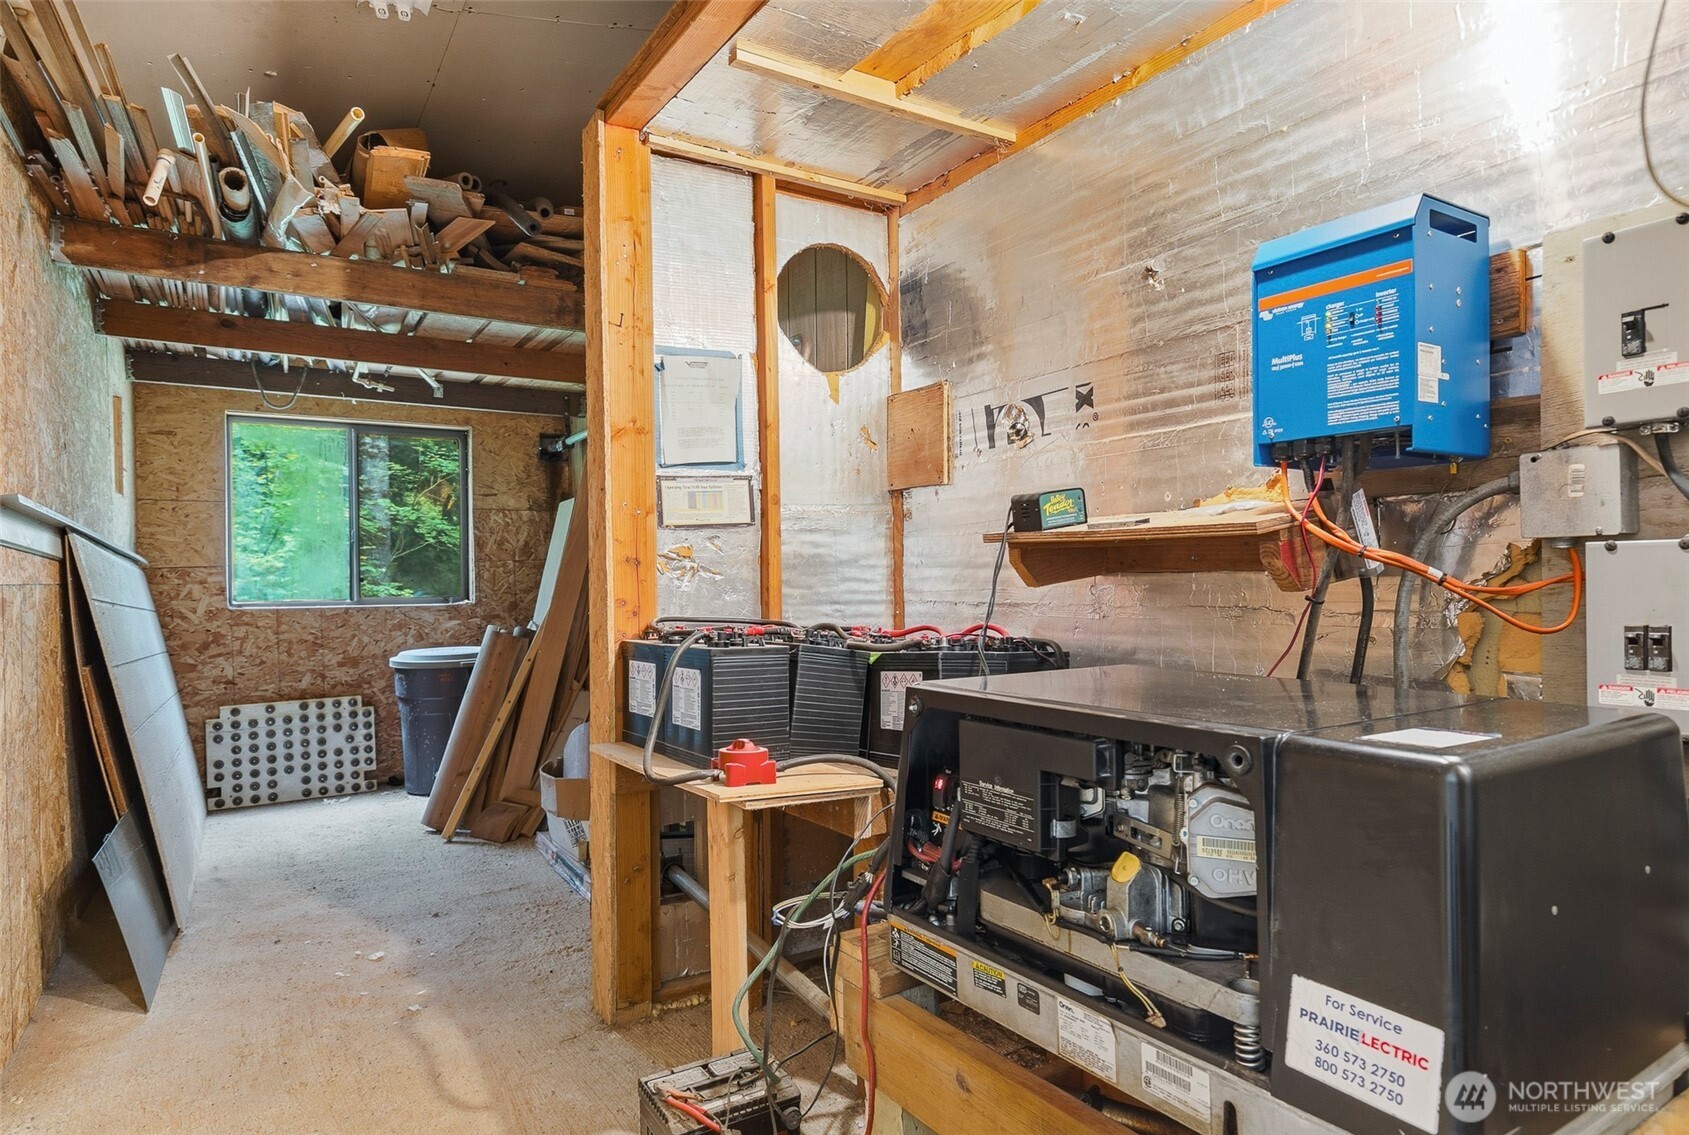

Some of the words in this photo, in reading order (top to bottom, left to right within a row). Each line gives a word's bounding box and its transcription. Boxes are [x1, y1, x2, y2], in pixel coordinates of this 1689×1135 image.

[1271, 354, 1303, 365] MultiPlus
[1043, 499, 1075, 516] Tender
[979, 964, 1003, 978] CAUTION
[1325, 995, 1345, 1011] For
[1349, 1004, 1402, 1035] Service
[1315, 1039, 1339, 1057] 360
[1343, 1051, 1366, 1070] 573
[1370, 1063, 1405, 1088] 2750
[1314, 1056, 1338, 1075] 800
[1341, 1069, 1365, 1088] 573
[1370, 1081, 1404, 1106] 2750
